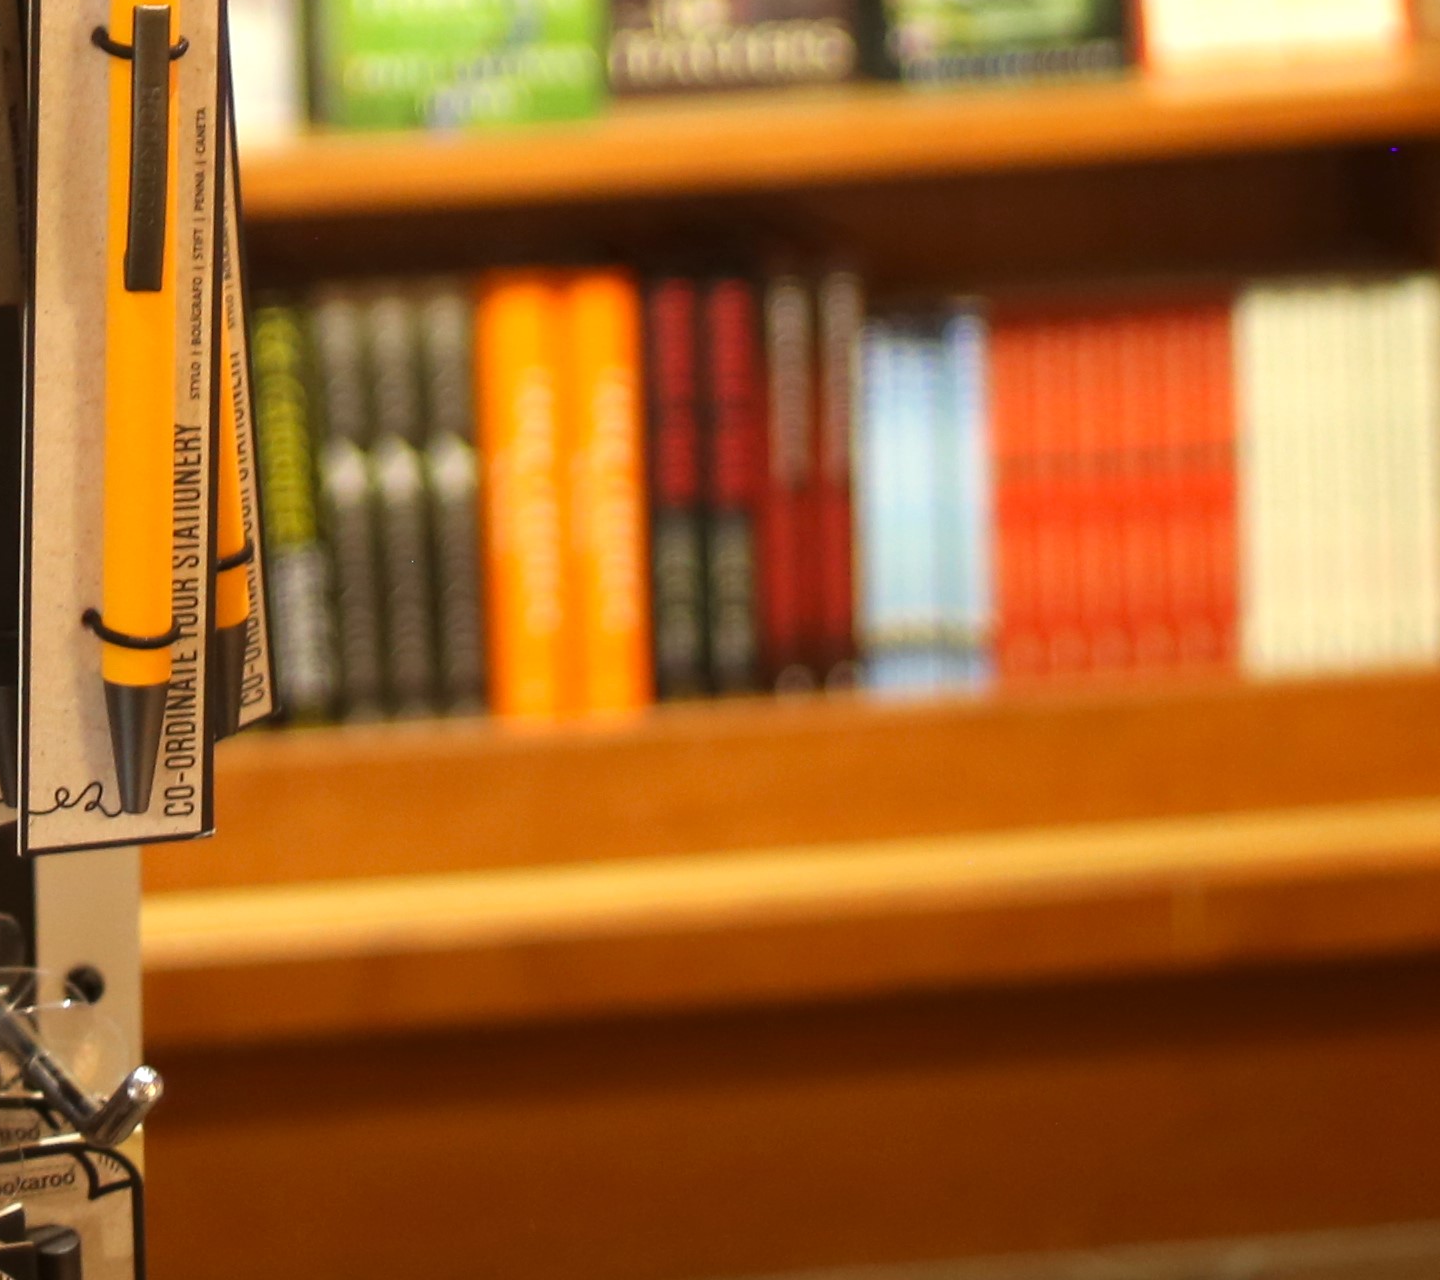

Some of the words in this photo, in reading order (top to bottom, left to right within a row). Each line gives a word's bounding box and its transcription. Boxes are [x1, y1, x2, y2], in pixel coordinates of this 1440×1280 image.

[195, 106, 207, 154] CANETA
[194, 170, 206, 213] PENNA
[192, 227, 204, 261] STIFT
[189, 360, 201, 401] STYLO
[173, 422, 202, 572] STATIONERY
[164, 639, 198, 817] CO-ORDINATE
